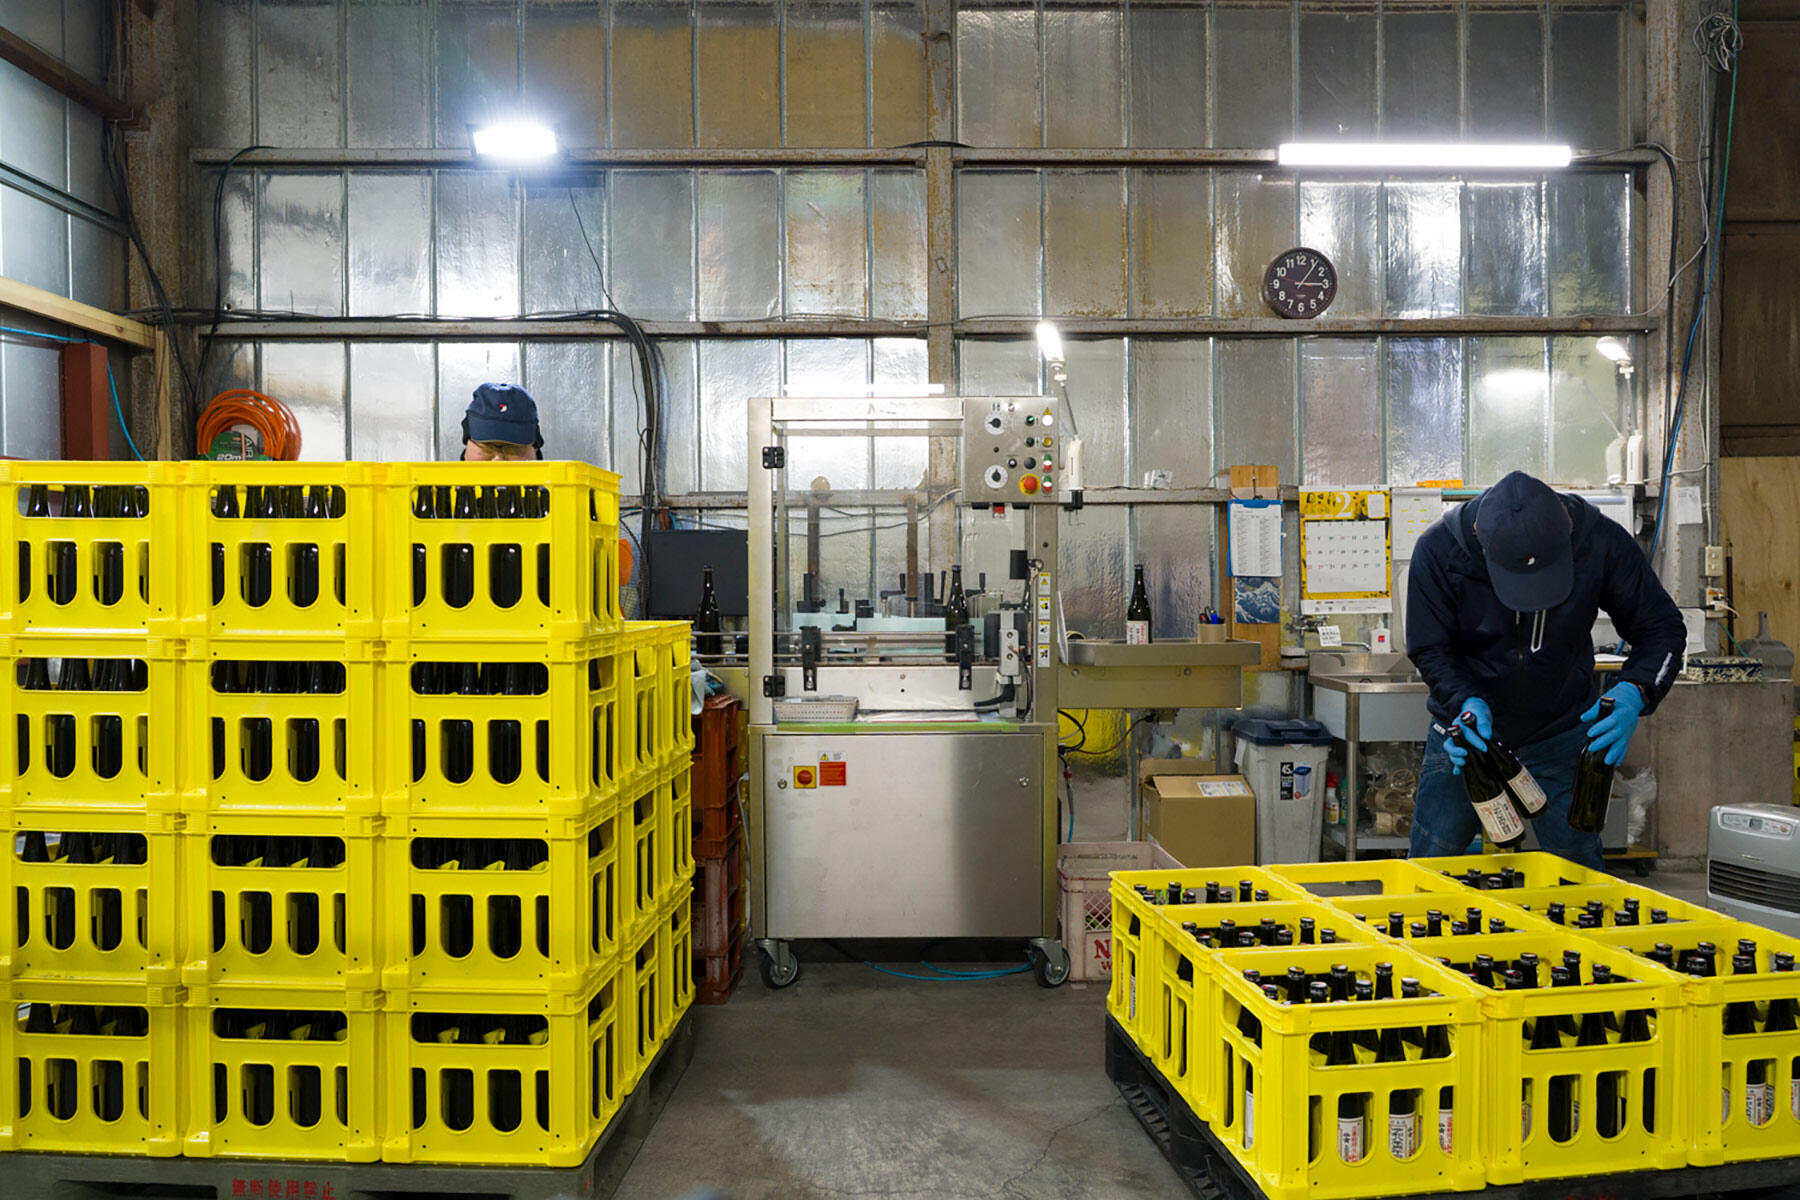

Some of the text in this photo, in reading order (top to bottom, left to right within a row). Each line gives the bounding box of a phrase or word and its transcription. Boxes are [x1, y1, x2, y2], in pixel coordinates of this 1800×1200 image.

[1286, 258, 1294, 269] 11
[1296, 255, 1307, 265] 12
[1276, 266, 1287, 277] 10
[1318, 266, 1325, 277] 2
[1273, 279, 1280, 289] 9
[1322, 279, 1329, 288] 3
[1278, 290, 1286, 301] 8
[1317, 290, 1324, 301] 4
[1287, 299, 1294, 309] 7
[1298, 302, 1305, 312] 6
[1310, 299, 1317, 309] 5
[1336, 492, 1353, 518] 2
